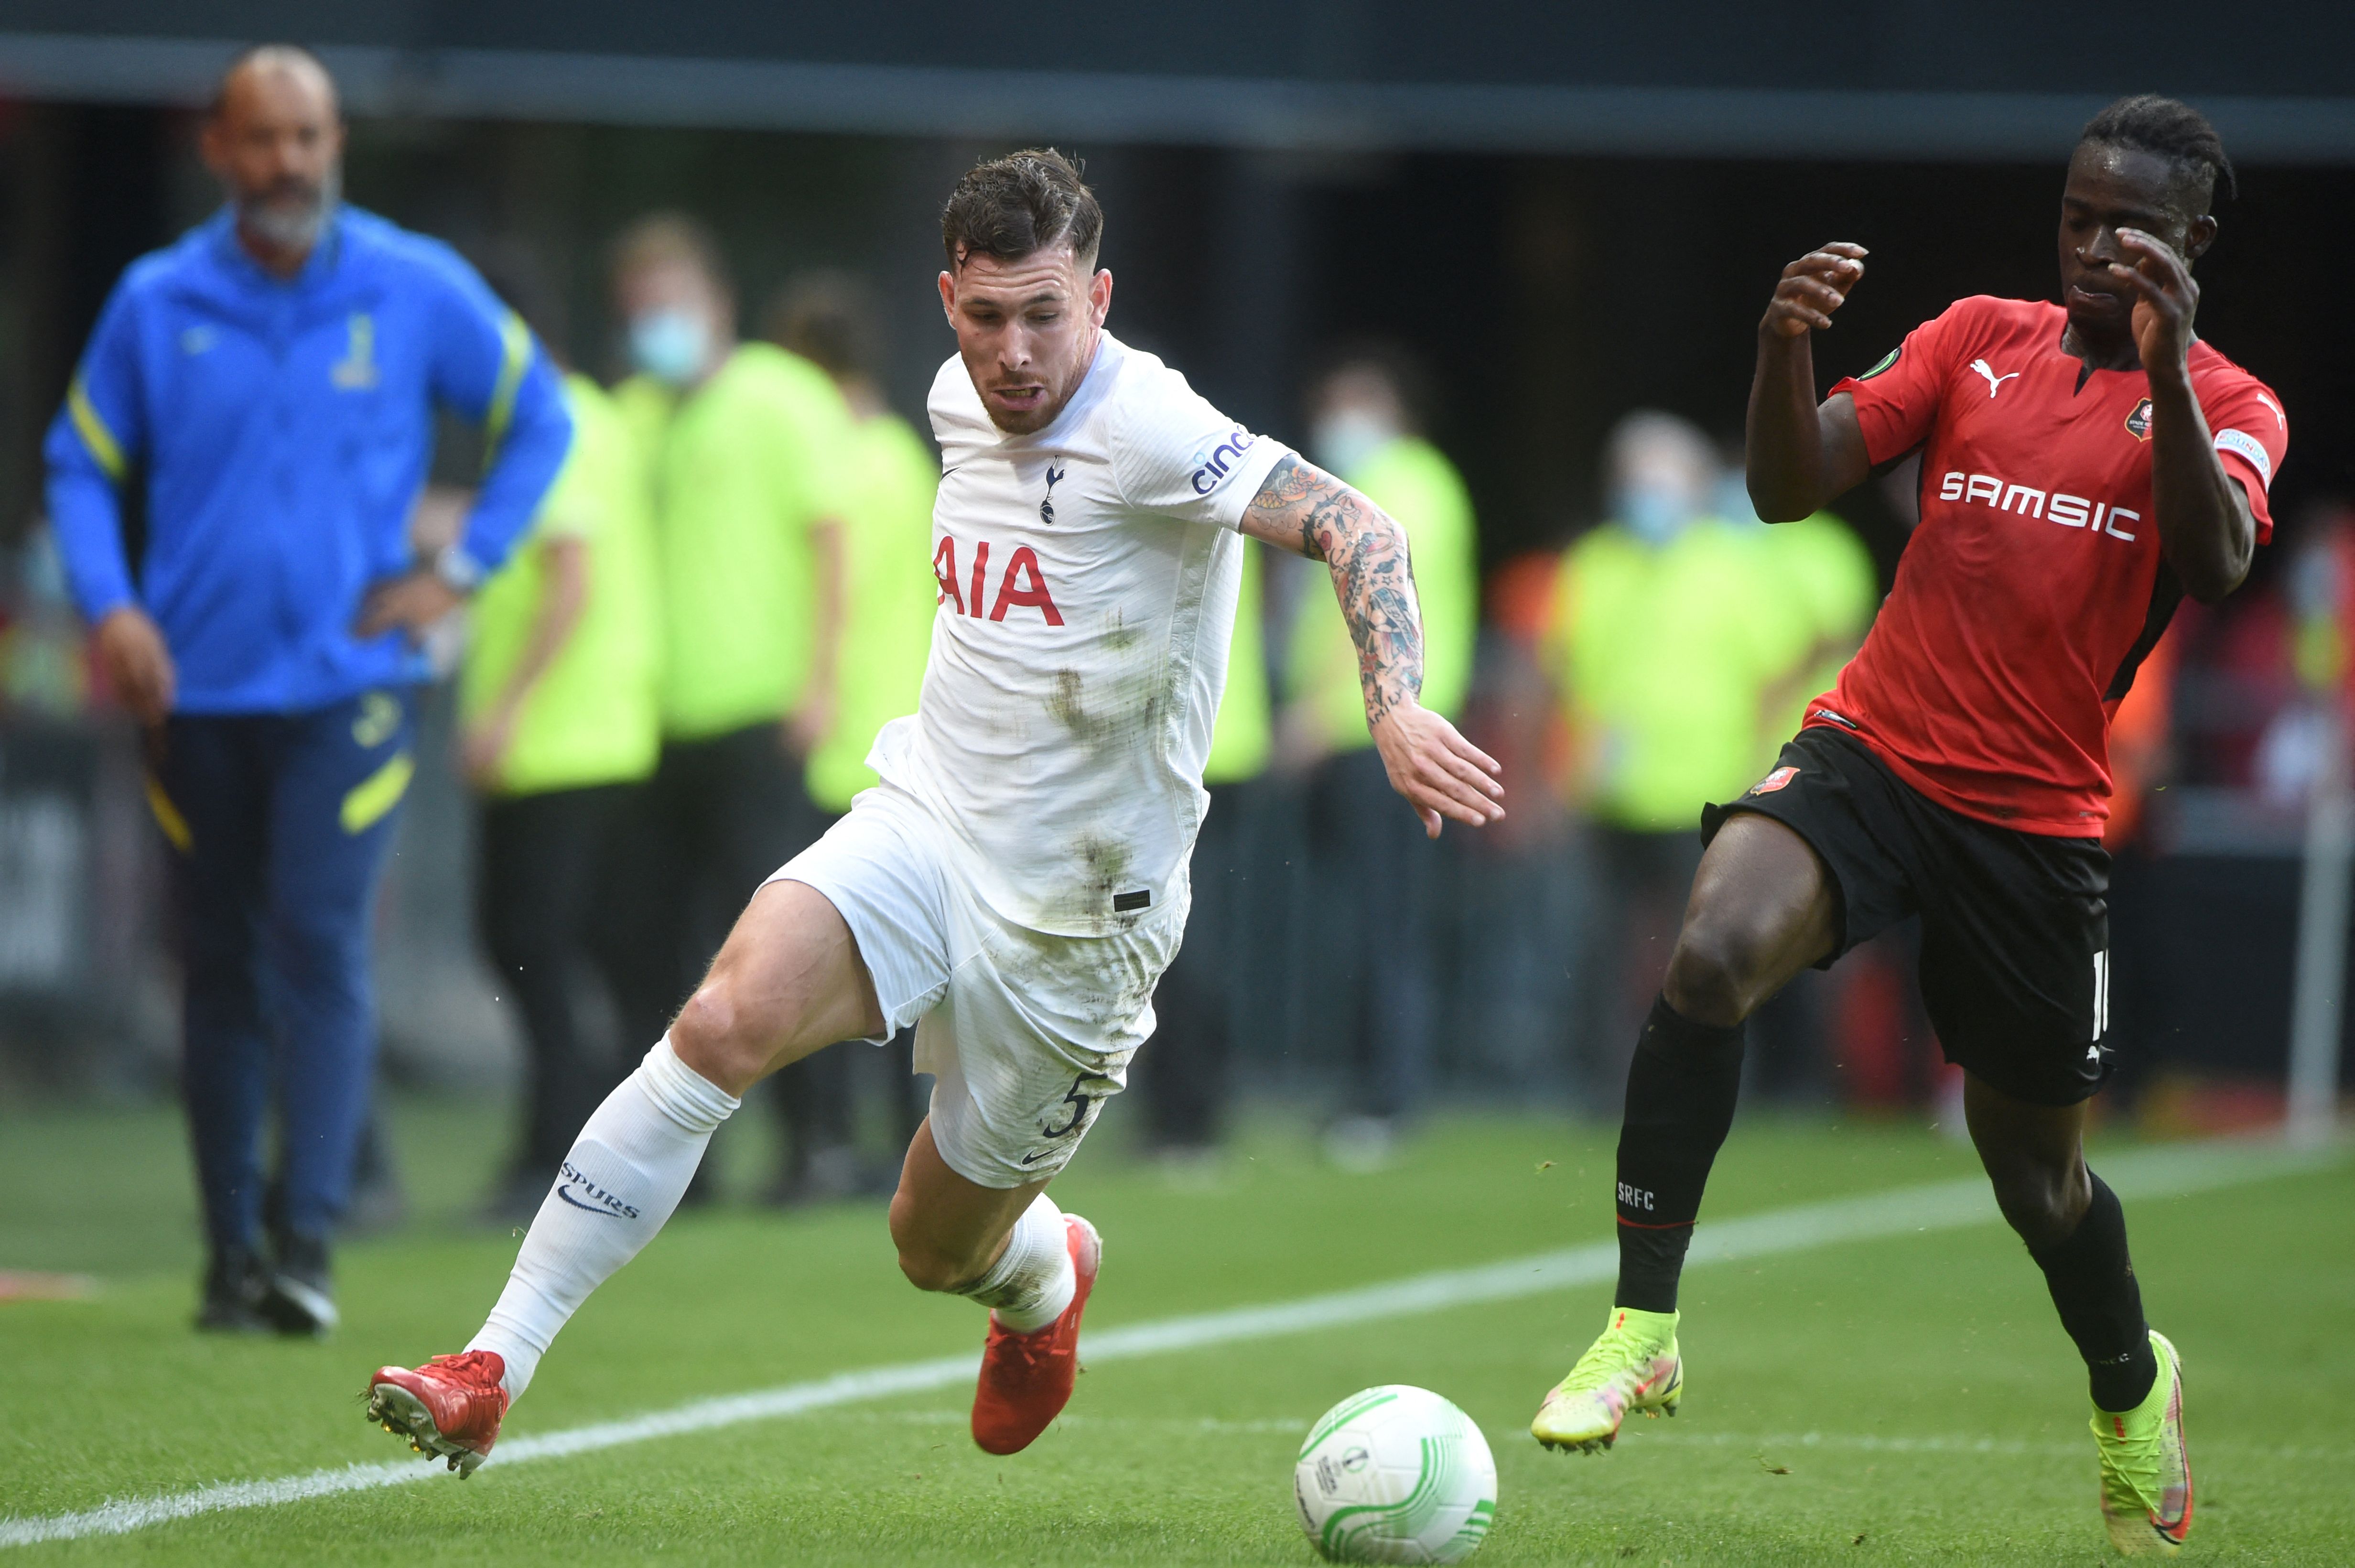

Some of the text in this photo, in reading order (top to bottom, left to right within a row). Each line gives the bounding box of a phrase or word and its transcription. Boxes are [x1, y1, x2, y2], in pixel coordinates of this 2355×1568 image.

[1192, 425, 1255, 495] cinc
[1940, 471, 2141, 541] SAMSIC
[933, 536, 1065, 626] AIA
[1043, 1071, 1108, 1138] 5
[561, 1162, 640, 1219] SPURS
[1618, 1181, 1653, 1211] SRFC
